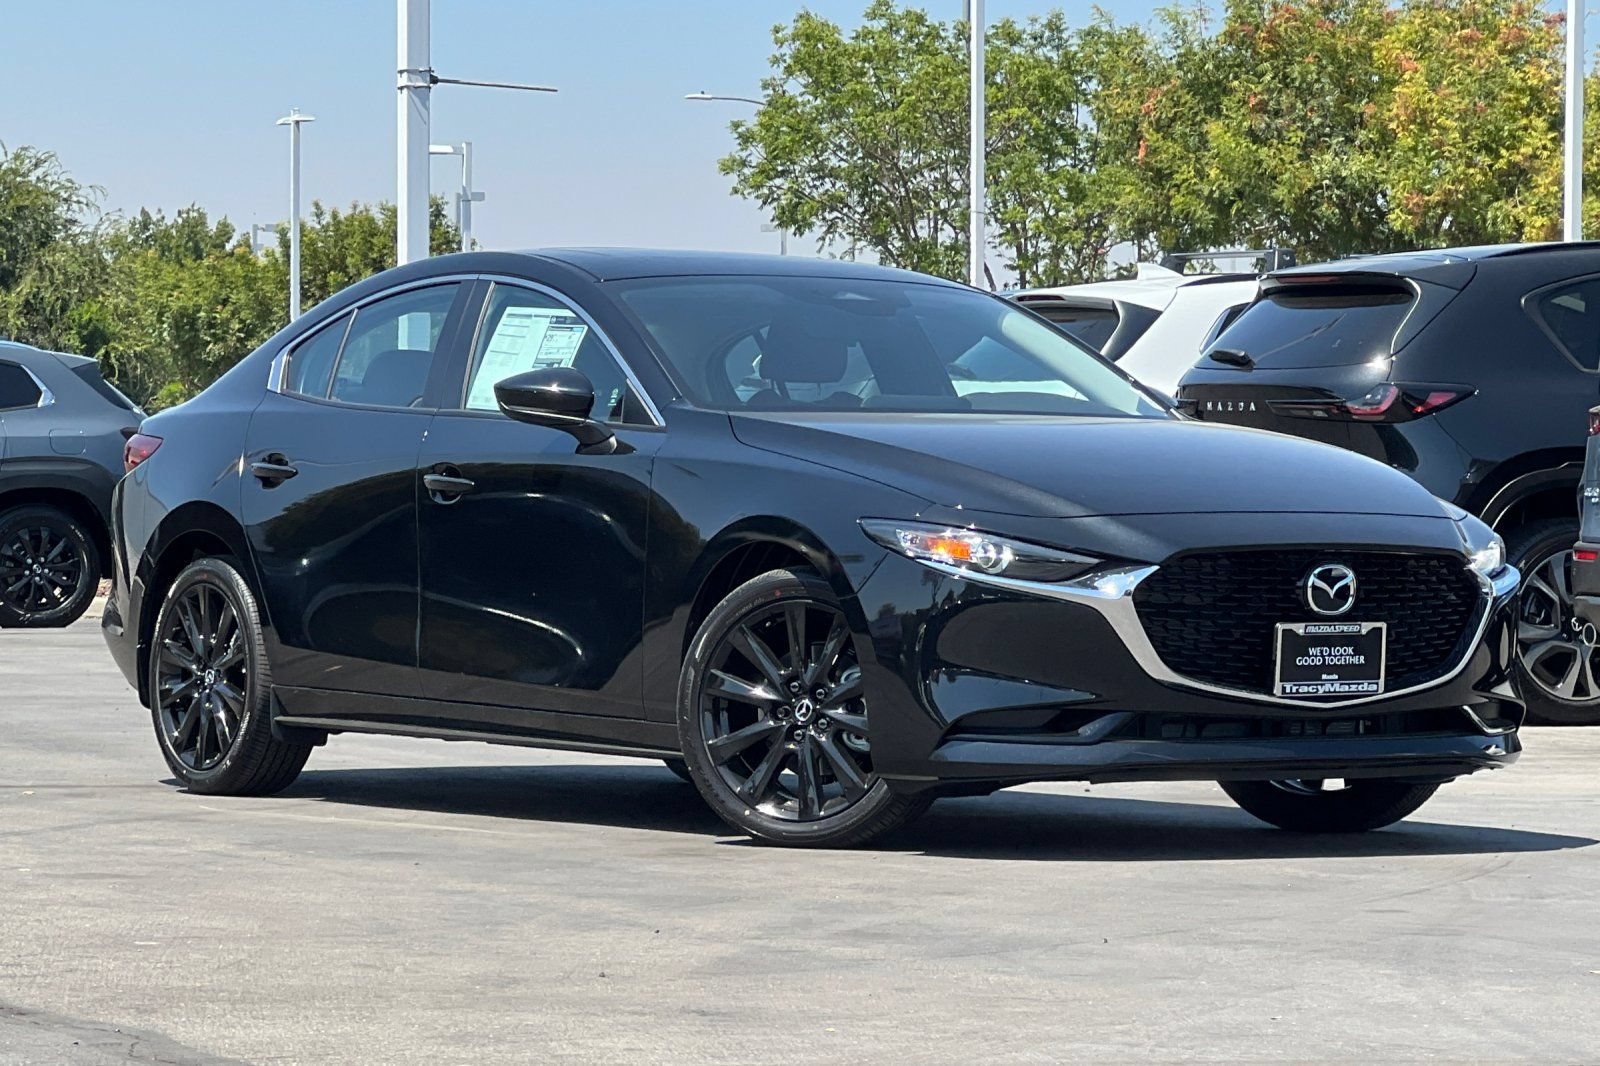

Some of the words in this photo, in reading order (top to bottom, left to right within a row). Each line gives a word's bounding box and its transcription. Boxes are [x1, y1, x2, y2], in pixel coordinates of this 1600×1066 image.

[1206, 401, 1256, 411] MAZDA
[1305, 624, 1360, 633] MAZDASPEED
[1308, 647, 1330, 656] WE'D
[1331, 646, 1354, 655] LOOK
[1296, 656, 1323, 665] GOOD
[1325, 655, 1365, 665] TOGETHER
[1283, 682, 1378, 694] TracyMazda
